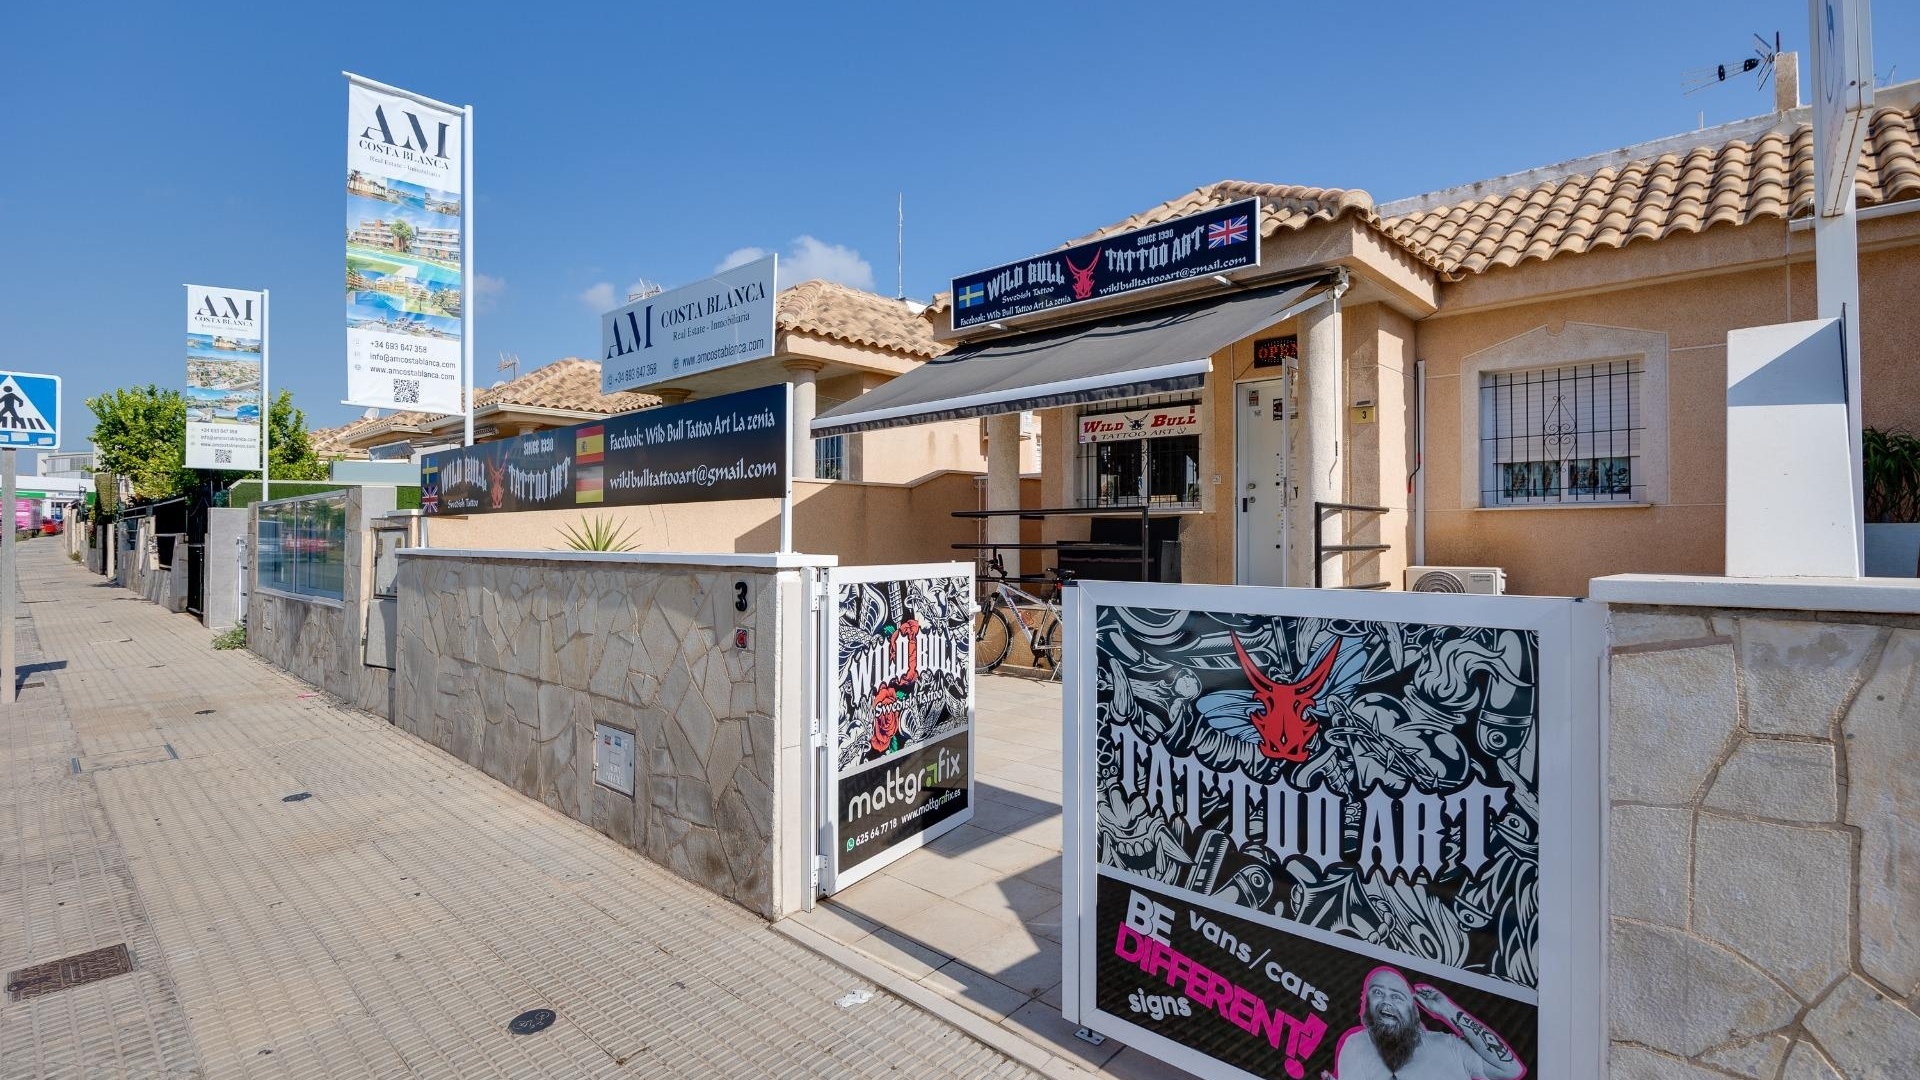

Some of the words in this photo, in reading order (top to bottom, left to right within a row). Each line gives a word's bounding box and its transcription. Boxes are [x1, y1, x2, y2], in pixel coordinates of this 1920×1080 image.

[360, 104, 450, 160] AM
[359, 140, 399, 158] COSTA
[403, 151, 449, 170] BLANCA
[369, 156, 383, 164] Real
[384, 160, 401, 168] Estate
[1105, 242, 1169, 273] TATTOO
[1171, 224, 1205, 264] ART
[1137, 232, 1157, 246] SINCE
[987, 265, 1024, 302] WILD
[1027, 260, 1065, 286] BULL
[1099, 255, 1247, 295] wildbulltattooart@gmail.com
[196, 294, 255, 321] AM
[661, 303, 703, 329] COSTA
[707, 281, 766, 316] BLANCA
[1001, 289, 1031, 304] Swedish
[1032, 286, 1055, 297] Tattoo
[194, 316, 221, 324] COSTA
[222, 319, 253, 327] BLANCA
[673, 326, 686, 341] Real
[687, 324, 706, 339] Estate
[710, 311, 750, 331] Inmobiliaria
[960, 315, 986, 327] Facebook:
[1001, 306, 1014, 317] Bull
[1014, 303, 1033, 315] Tattoo
[1033, 301, 1044, 311] Art
[1045, 299, 1054, 307] La
[369, 340, 384, 350] +34
[385, 341, 399, 351] 693
[400, 343, 413, 352] 647
[414, 345, 427, 354] 358
[606, 304, 655, 360] AM
[369, 352, 456, 369] info@amcostablanca.com
[682, 337, 765, 368] www.amcostablanca.com
[370, 366, 455, 380] www.amcostablanca.com
[614, 372, 625, 384] +34
[625, 369, 636, 382] 693
[636, 367, 646, 380] 647
[610, 428, 644, 450] Facebook:
[667, 418, 684, 442] Bull
[685, 418, 713, 440] Tattoo
[713, 414, 731, 436] Art
[732, 412, 745, 432] La
[747, 407, 776, 431] zenia
[1083, 420, 1125, 433] WILD
[1150, 414, 1197, 428] BULL
[1362, 410, 1367, 420] 3
[1101, 430, 1147, 440] TATTOO
[1150, 428, 1174, 437] ART
[441, 457, 462, 496] WILD
[464, 455, 487, 492] BULL
[508, 463, 548, 504] TATTOO
[549, 455, 571, 500] ART
[609, 457, 777, 490] wildbulltattooart@gmail.com
[734, 581, 748, 612] 3
[849, 635, 909, 707] WILD
[915, 631, 962, 678] BULL
[875, 694, 916, 717] Swedish
[917, 688, 944, 703] Tattoo
[1109, 722, 1346, 872] TATTOO
[1358, 783, 1510, 885] ART
[856, 831, 869, 847] 625
[870, 826, 880, 840] 64
[880, 822, 889, 834] 77
[889, 817, 898, 831] 18
[1125, 889, 1176, 948] BE
[1115, 920, 1328, 1079] DIFFERENT!
[1128, 987, 1192, 1021] signs
